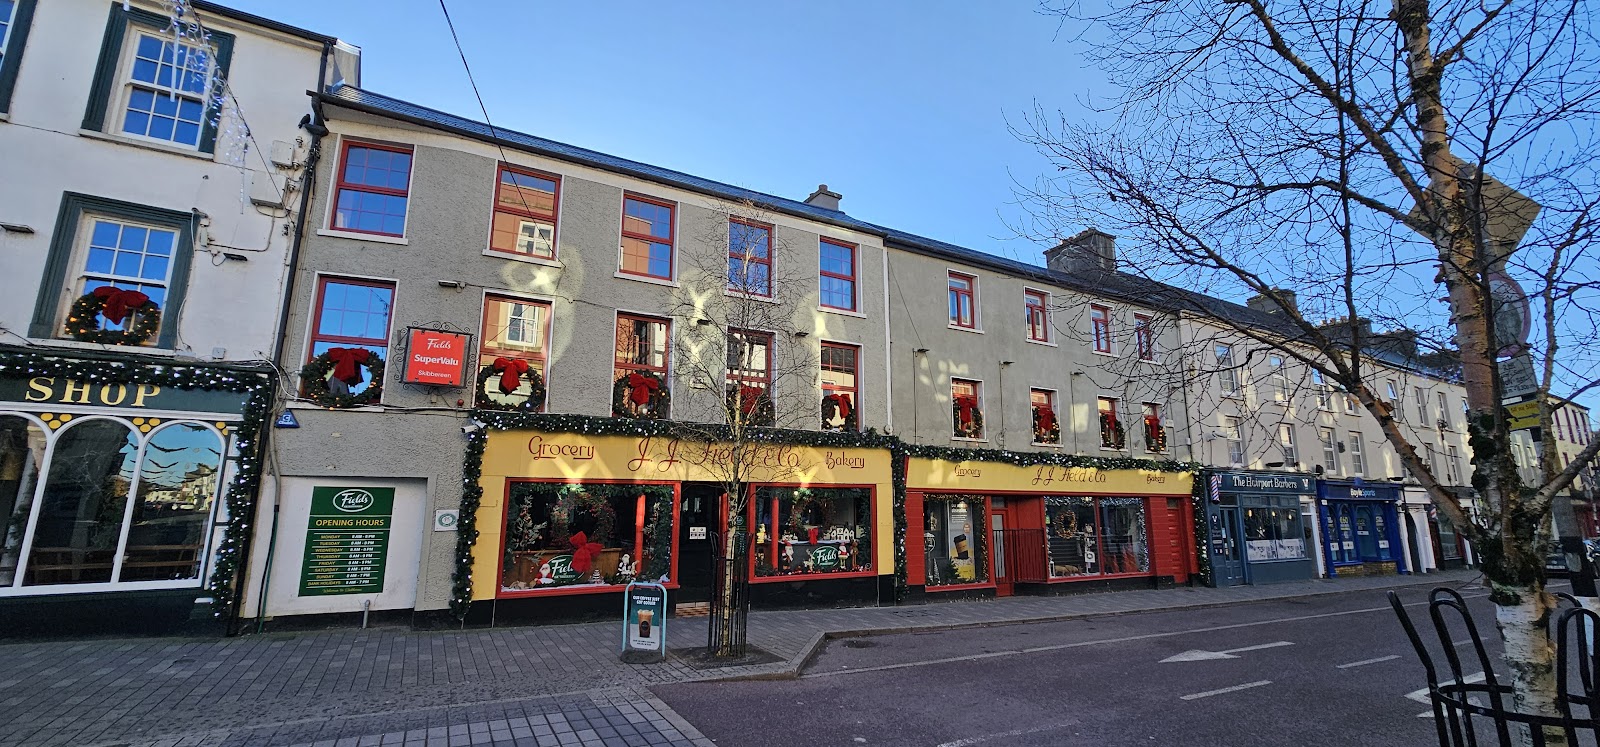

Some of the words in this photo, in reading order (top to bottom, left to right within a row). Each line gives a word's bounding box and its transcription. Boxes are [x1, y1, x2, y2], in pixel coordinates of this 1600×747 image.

[427, 338, 451, 350] Fields
[414, 354, 459, 366] SuperValu
[418, 369, 452, 378] Skibbereen
[25, 376, 161, 407] SHOP
[528, 435, 595, 461] Grocery
[825, 451, 865, 470] Bakery
[954, 464, 981, 478] Grocery
[1233, 475, 1245, 488] The
[1246, 476, 1274, 490] Hairport
[1274, 479, 1297, 490] Barbers
[341, 492, 368, 508] Fields
[1350, 488, 1376, 498] BoyleSports
[816, 549, 837, 564] Fields
